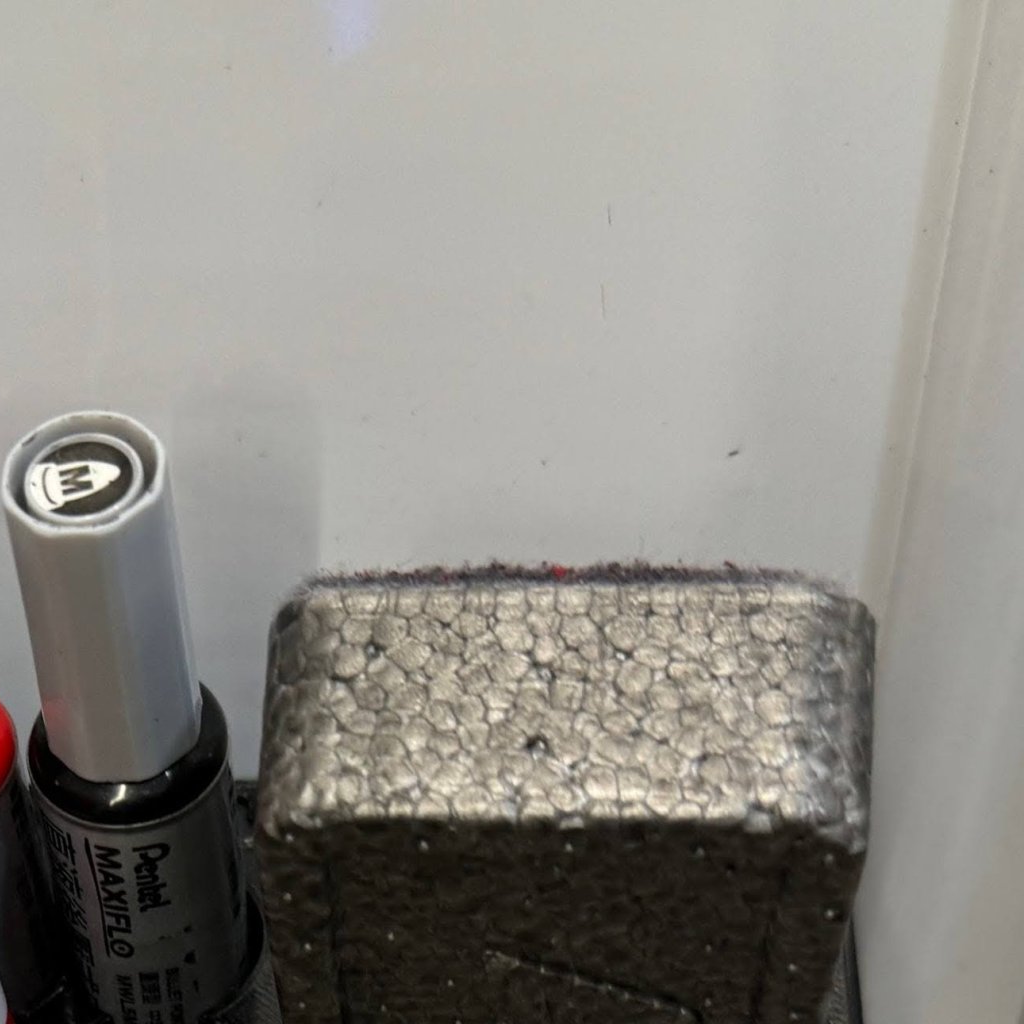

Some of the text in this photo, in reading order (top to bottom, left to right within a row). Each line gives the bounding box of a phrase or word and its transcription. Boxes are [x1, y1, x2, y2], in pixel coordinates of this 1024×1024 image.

[59, 467, 94, 495] M
[93, 844, 135, 960] MAXIFLO
[132, 842, 172, 914] Pentel
